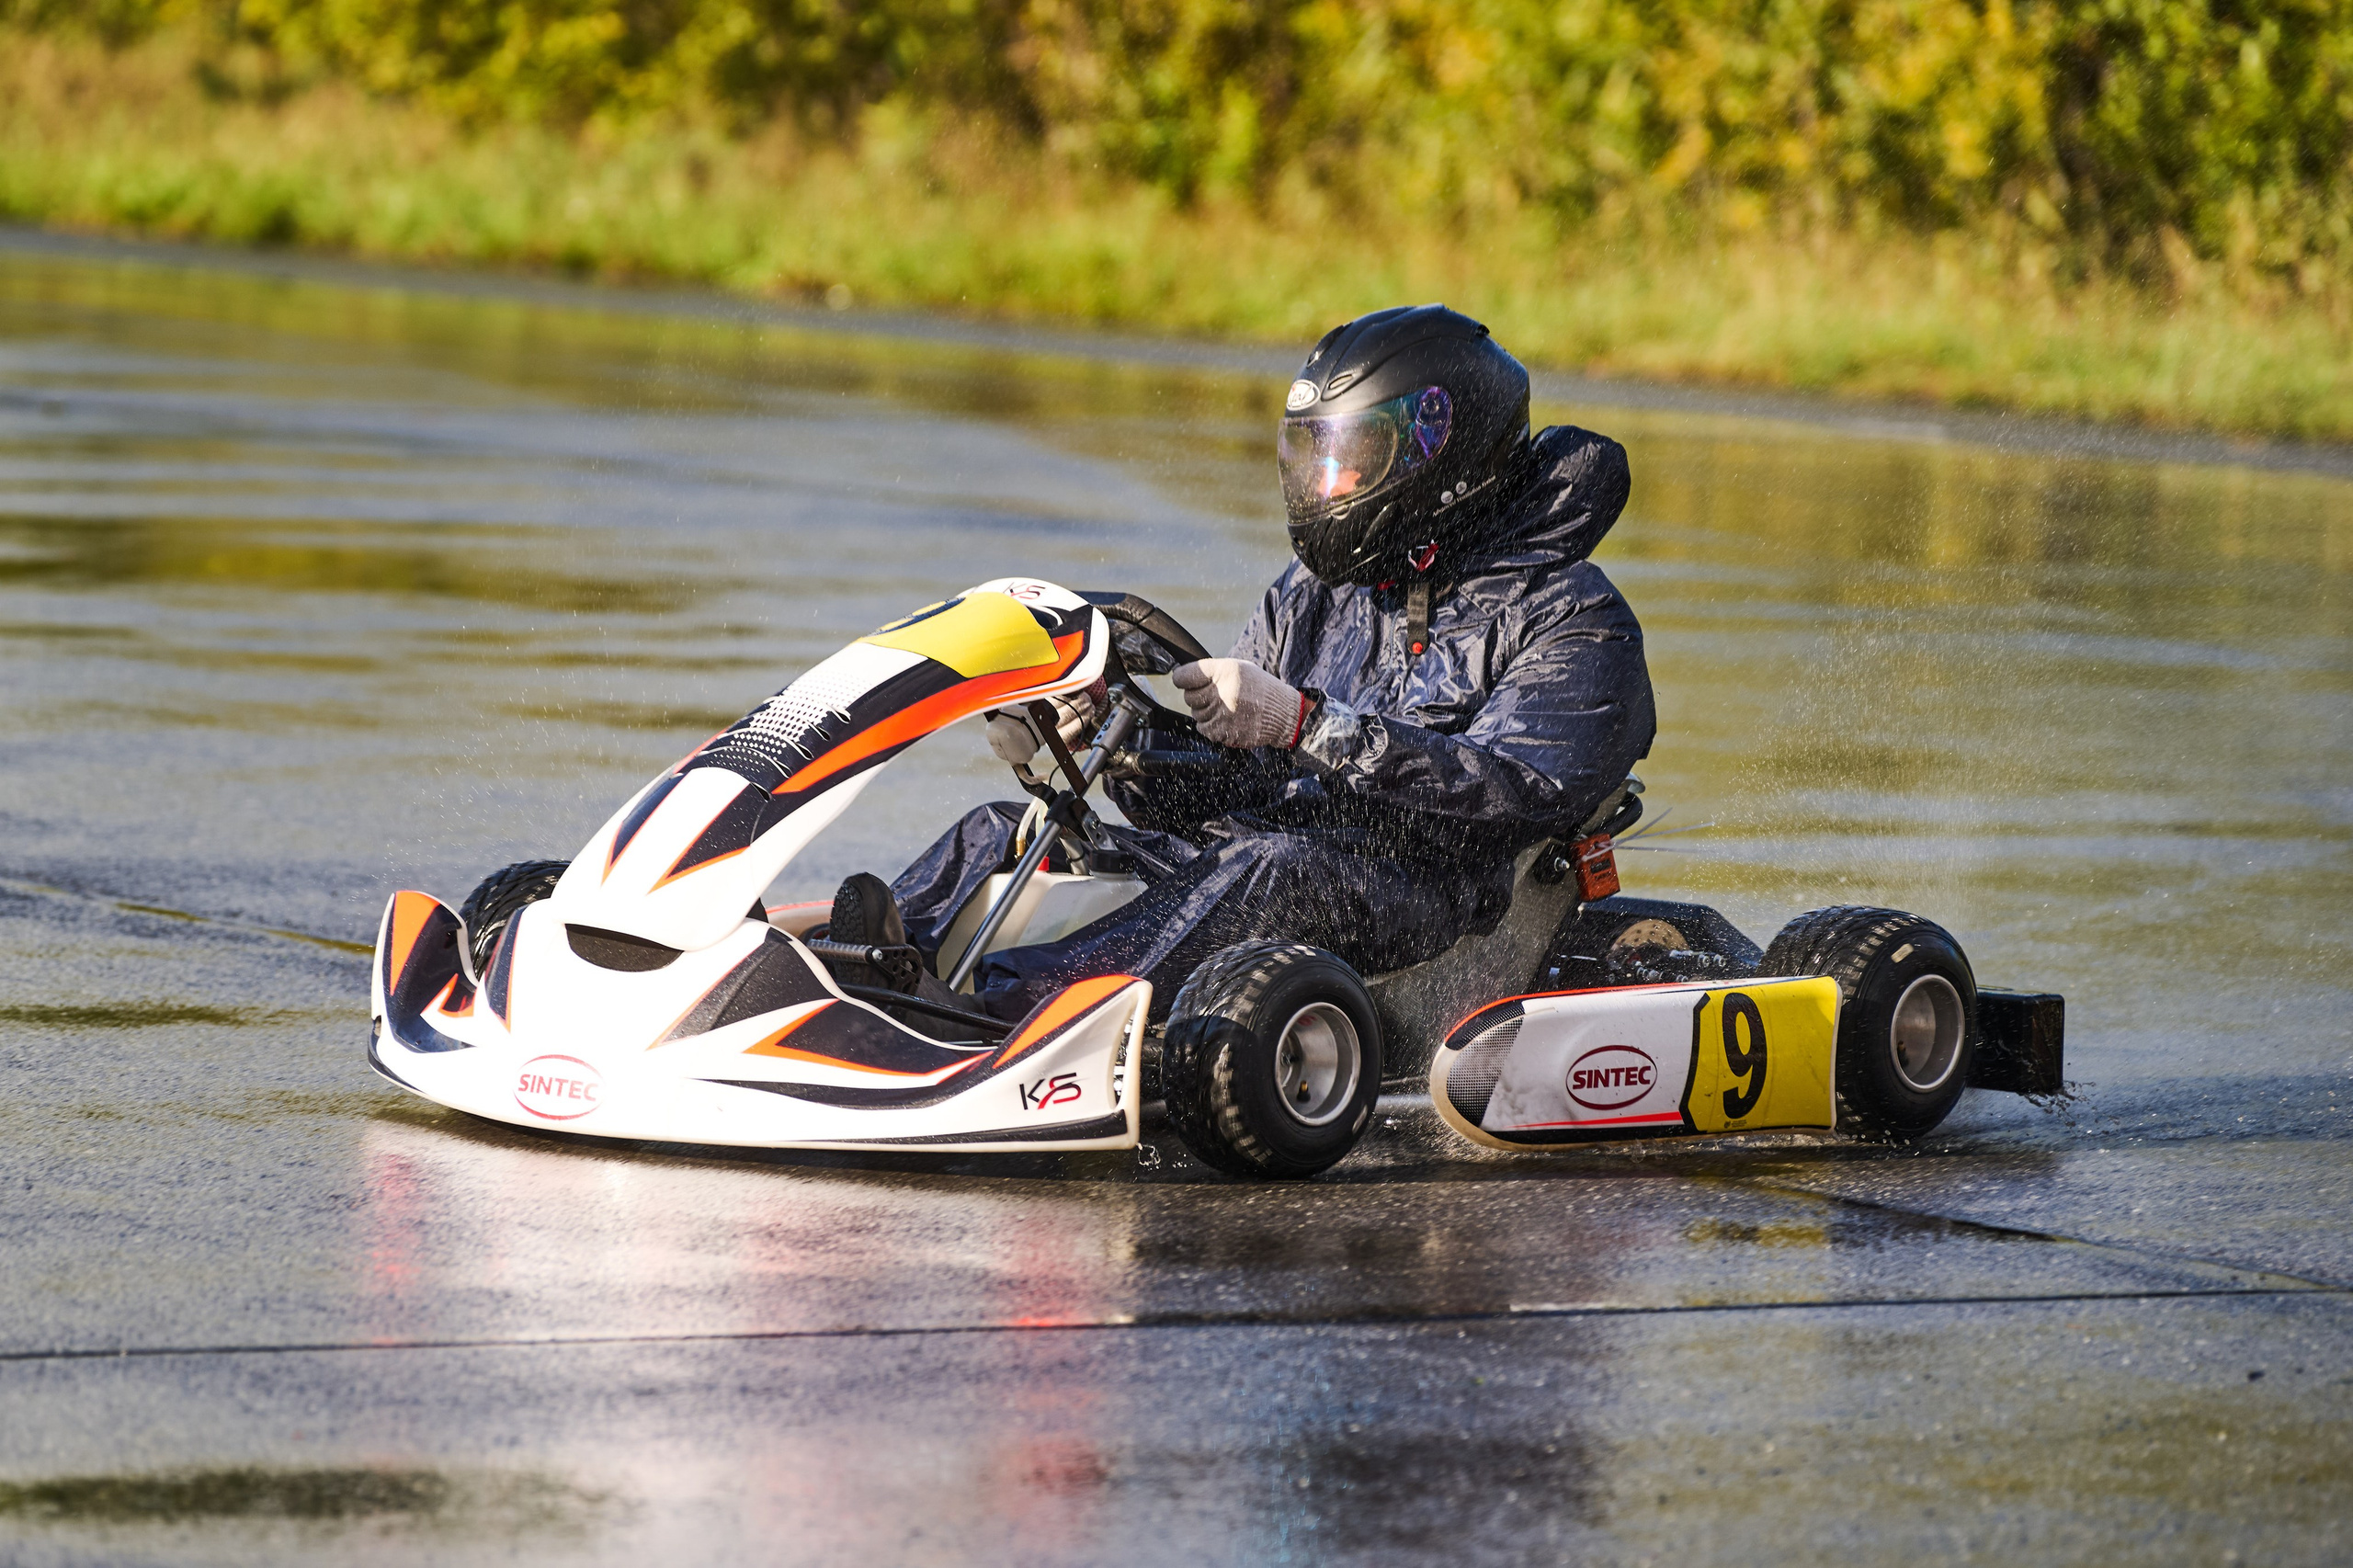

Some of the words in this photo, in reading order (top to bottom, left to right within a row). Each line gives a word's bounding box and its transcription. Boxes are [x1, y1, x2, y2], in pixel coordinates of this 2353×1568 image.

[1722, 992, 1768, 1119] 9
[517, 1074, 598, 1102] SINTEC
[1572, 1065, 1652, 1090] SINTEC
